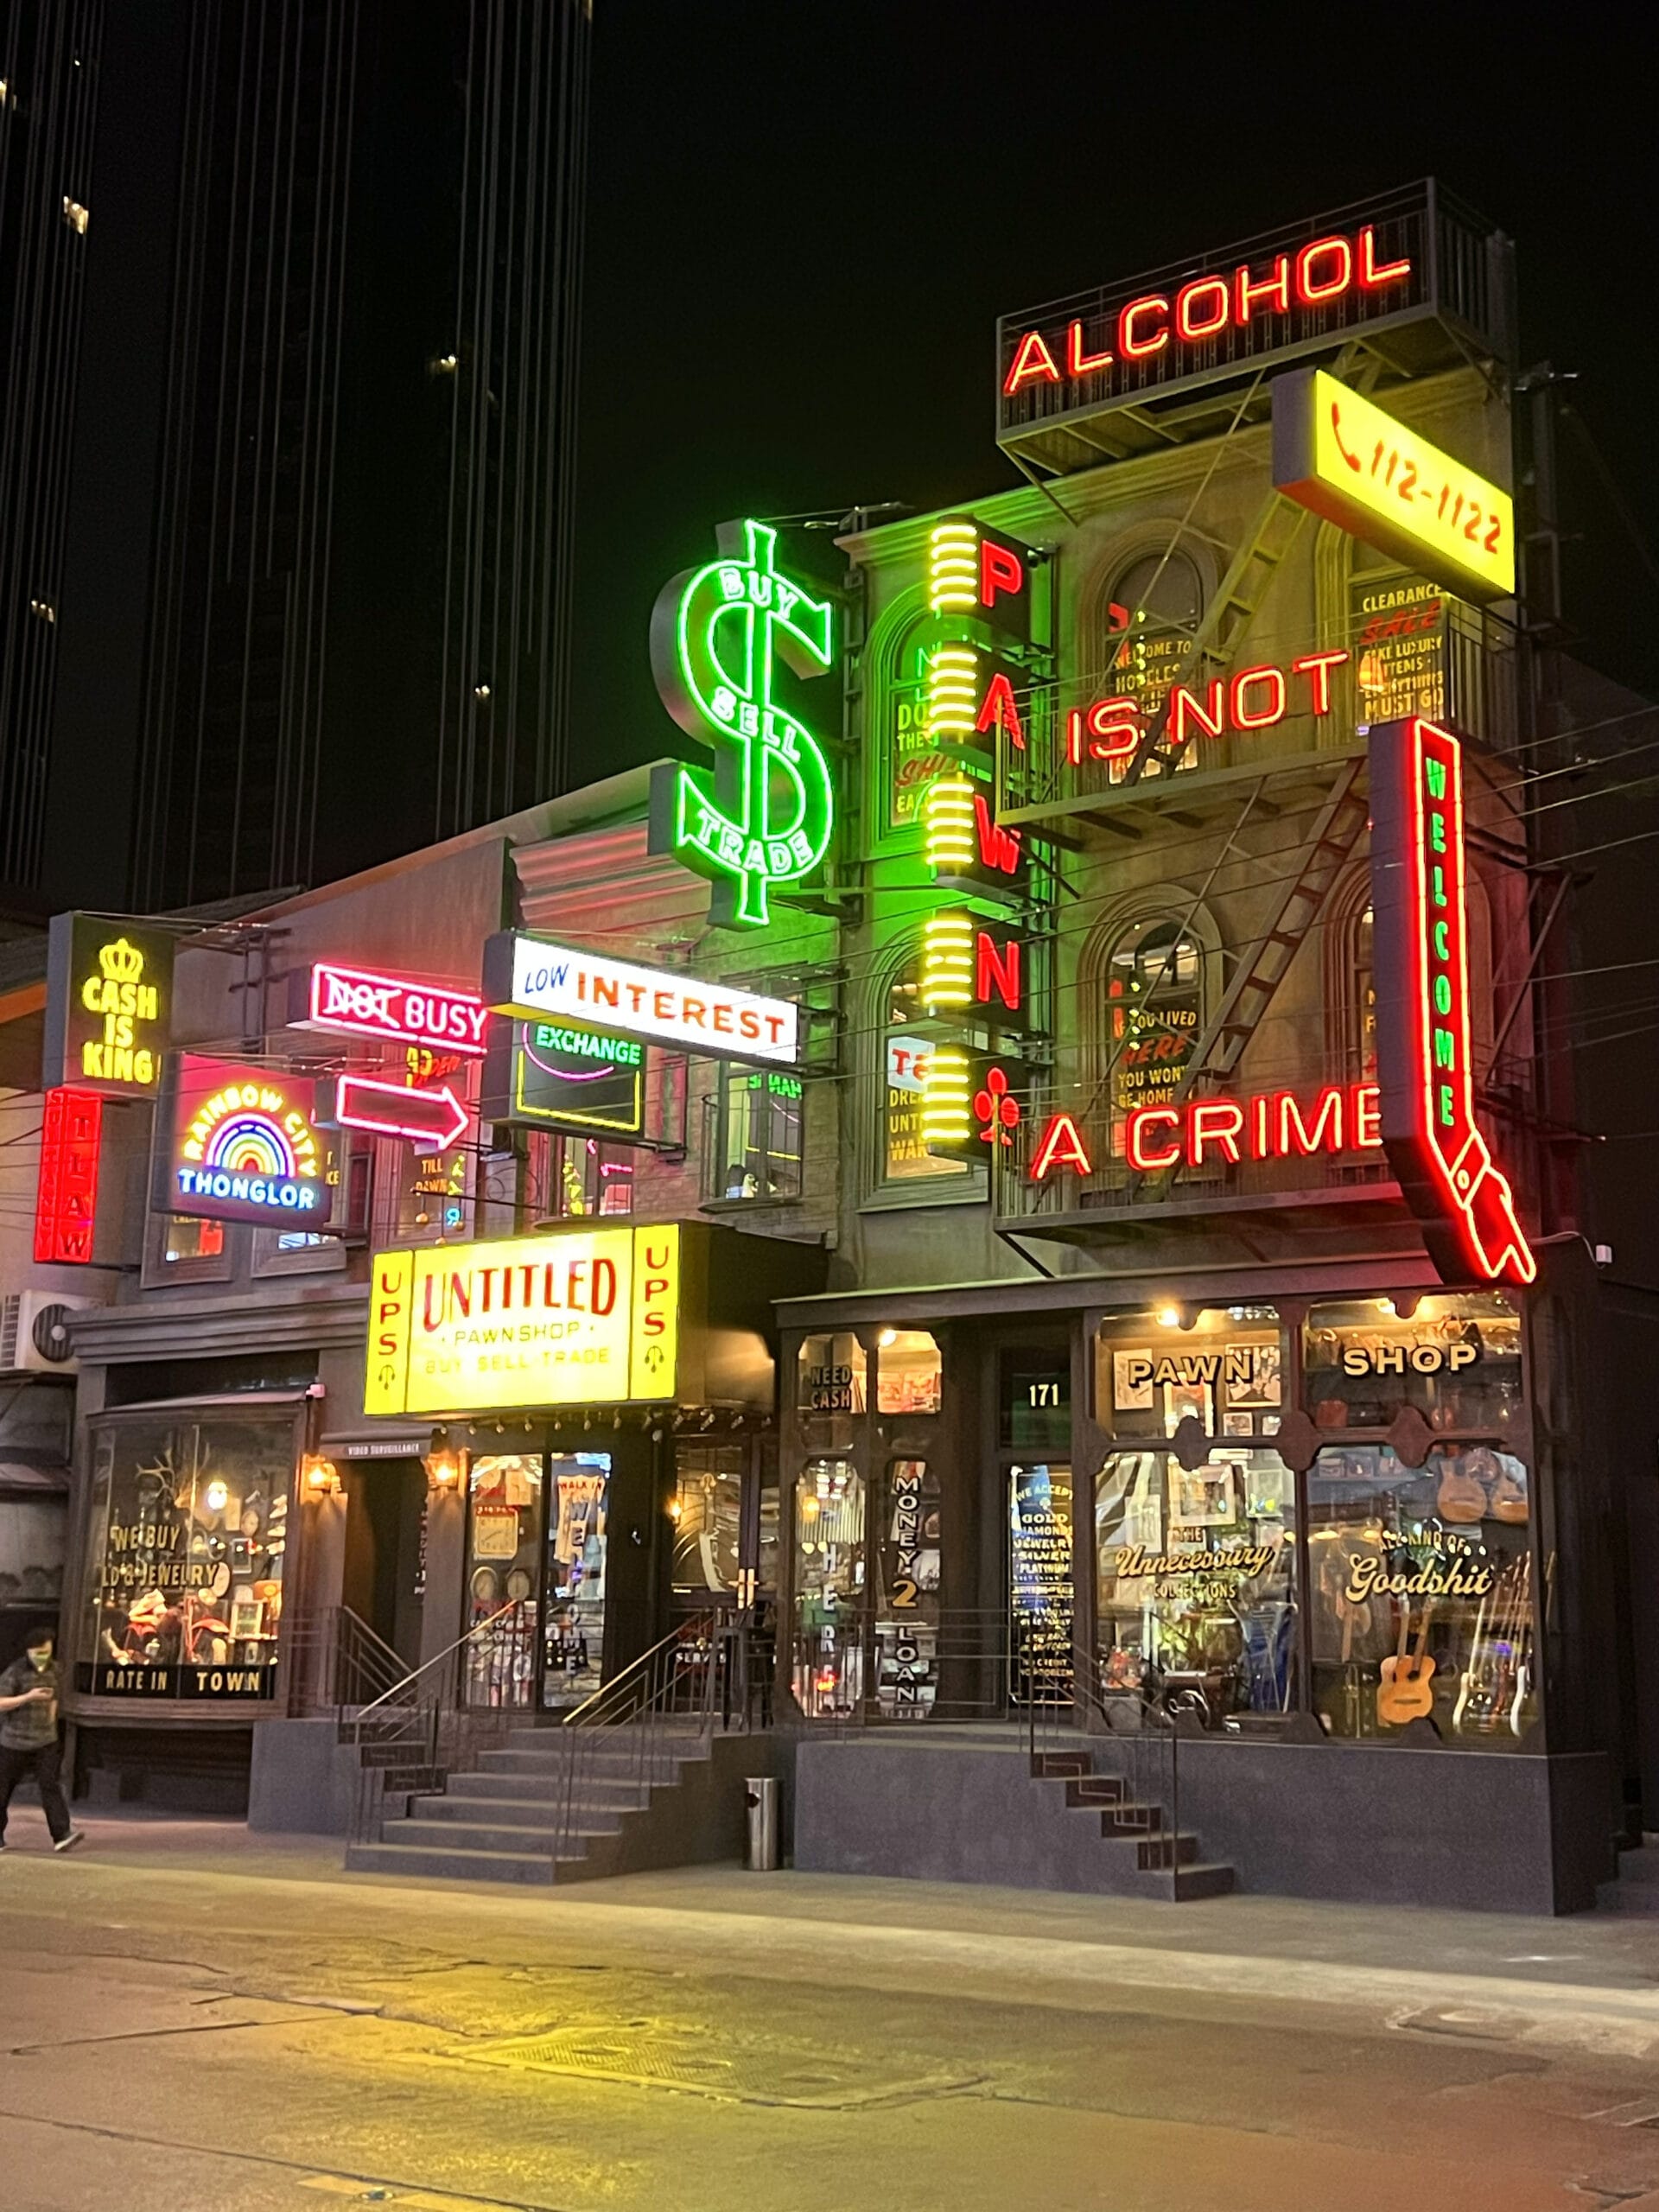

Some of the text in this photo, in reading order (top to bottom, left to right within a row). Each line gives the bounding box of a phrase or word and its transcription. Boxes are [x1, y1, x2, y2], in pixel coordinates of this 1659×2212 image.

[1004, 224, 1411, 395] ALCOHOL
[1370, 439, 1501, 555] 112-1122
[718, 566, 799, 620] BUY
[1362, 582, 1442, 613] CLEARANCE
[1114, 639, 1192, 670] WELOME TO
[1395, 635, 1443, 658] LUXURY
[710, 686, 802, 762] SELL
[1066, 649, 1350, 766] IS NOT
[1364, 693, 1414, 720] MUST
[895, 753, 955, 788] SHI
[974, 538, 1026, 1011] PAWN
[696, 810, 814, 876] TRADE
[1425, 756, 1454, 1128] WELCOME
[81, 976, 160, 1020] CASH
[524, 963, 785, 1044] LOW INTEREST
[104, 1013, 135, 1048] IS
[404, 995, 487, 1041] BUSY
[1160, 1010, 1197, 1027] LIVED
[536, 1024, 642, 1065] EXCHANGE
[82, 1041, 155, 1084] KING
[1118, 1071, 1145, 1089] YOU
[183, 1084, 317, 1177] RAINBOW CITY
[1030, 1081, 1383, 1181] A CRIME
[422, 1157, 443, 1174] TILL
[178, 1167, 315, 1210] THONGLOR
[423, 1258, 617, 1333] UNTITLED
[643, 1245, 670, 1337] UPS
[378, 1271, 403, 1356] UPS
[426, 1347, 610, 1374] BUY SELL TRADE
[810, 1365, 852, 1387] NEED
[1128, 1354, 1253, 1386] PAWN
[1343, 1344, 1478, 1376] SHOP
[810, 1389, 851, 1410] CASH
[1029, 1383, 1058, 1408] 171
[348, 1443, 420, 1456] VIDEO SURVEILLANCE
[895, 1477, 920, 1571] MONEY
[1021, 1513, 1069, 1524] GOLD
[111, 1524, 181, 1552] WE BUY
[1408, 1530, 1442, 1548] KIND
[139, 1561, 218, 1588] JEWELRY
[1115, 1544, 1273, 1578] Unnecessary
[1345, 1553, 1492, 1602] Goodshit
[891, 1579, 918, 1609] 2
[1154, 1583, 1237, 1599] COLLECTIONS
[105, 1669, 260, 1692] RATE IN TOWN
[895, 1626, 919, 1704] LOAN
